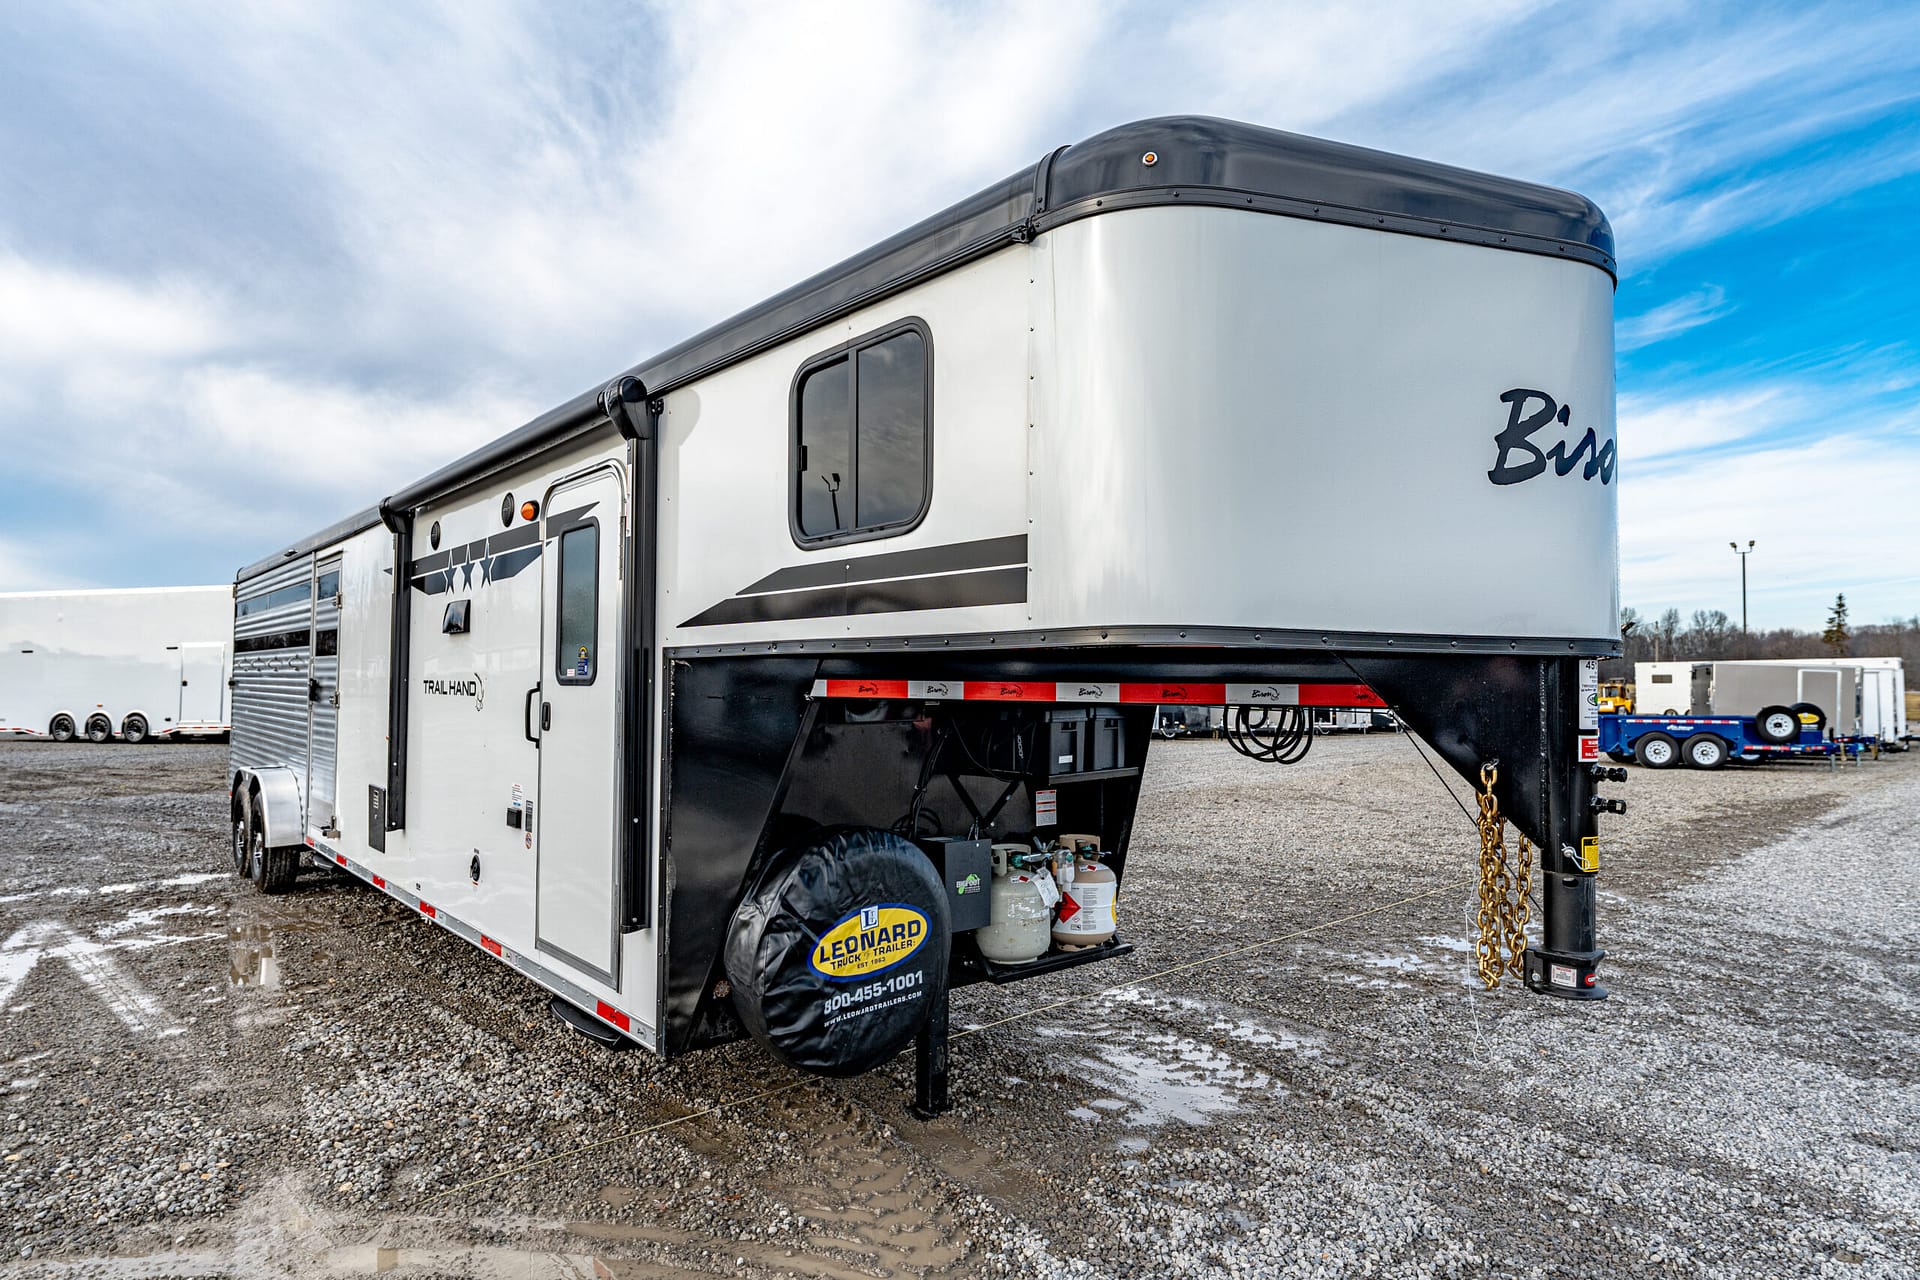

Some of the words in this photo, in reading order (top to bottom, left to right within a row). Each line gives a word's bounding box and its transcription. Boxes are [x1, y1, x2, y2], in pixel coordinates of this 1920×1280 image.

[1488, 388, 1617, 485] Biso
[423, 680, 448, 695] TRAIL
[449, 680, 477, 697] HAND
[819, 919, 921, 964] LEONARD
[829, 953, 861, 970] TRUCK
[873, 940, 913, 956] TRAILER
[823, 970, 923, 1015] 800-455-1001
